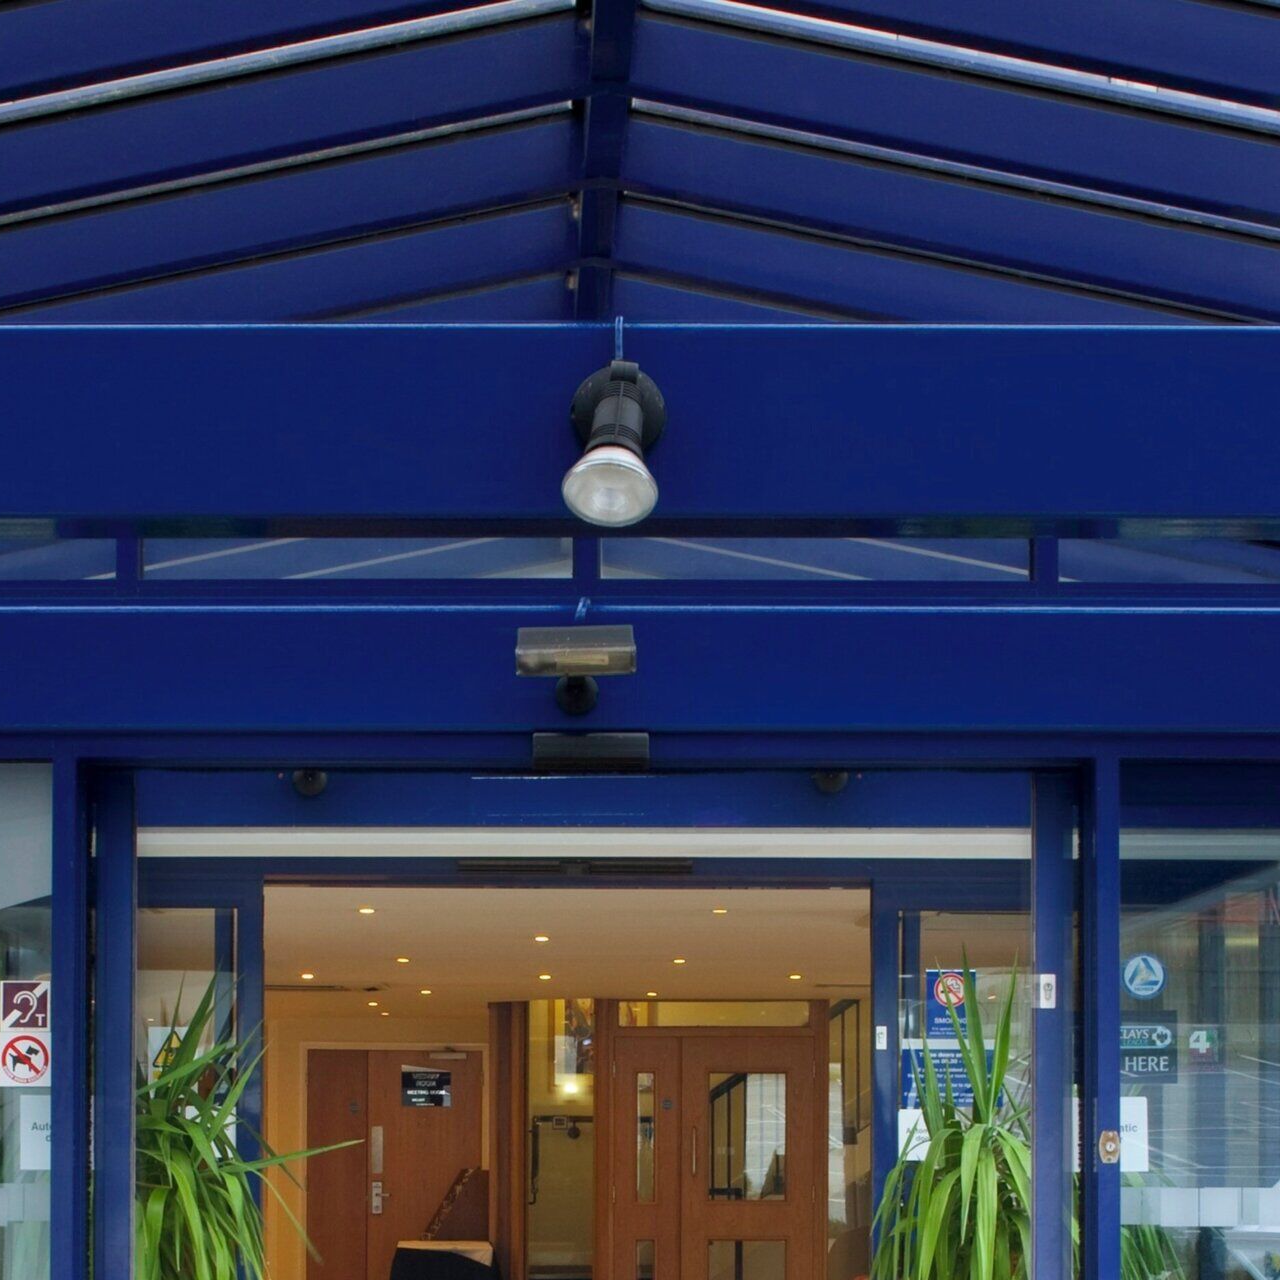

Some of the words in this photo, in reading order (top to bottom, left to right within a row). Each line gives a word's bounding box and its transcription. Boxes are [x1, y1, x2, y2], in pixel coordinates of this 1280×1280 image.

[35, 1013, 46, 1026] T
[1189, 1030, 1210, 1053] 4
[1125, 1056, 1169, 1072] HERE
